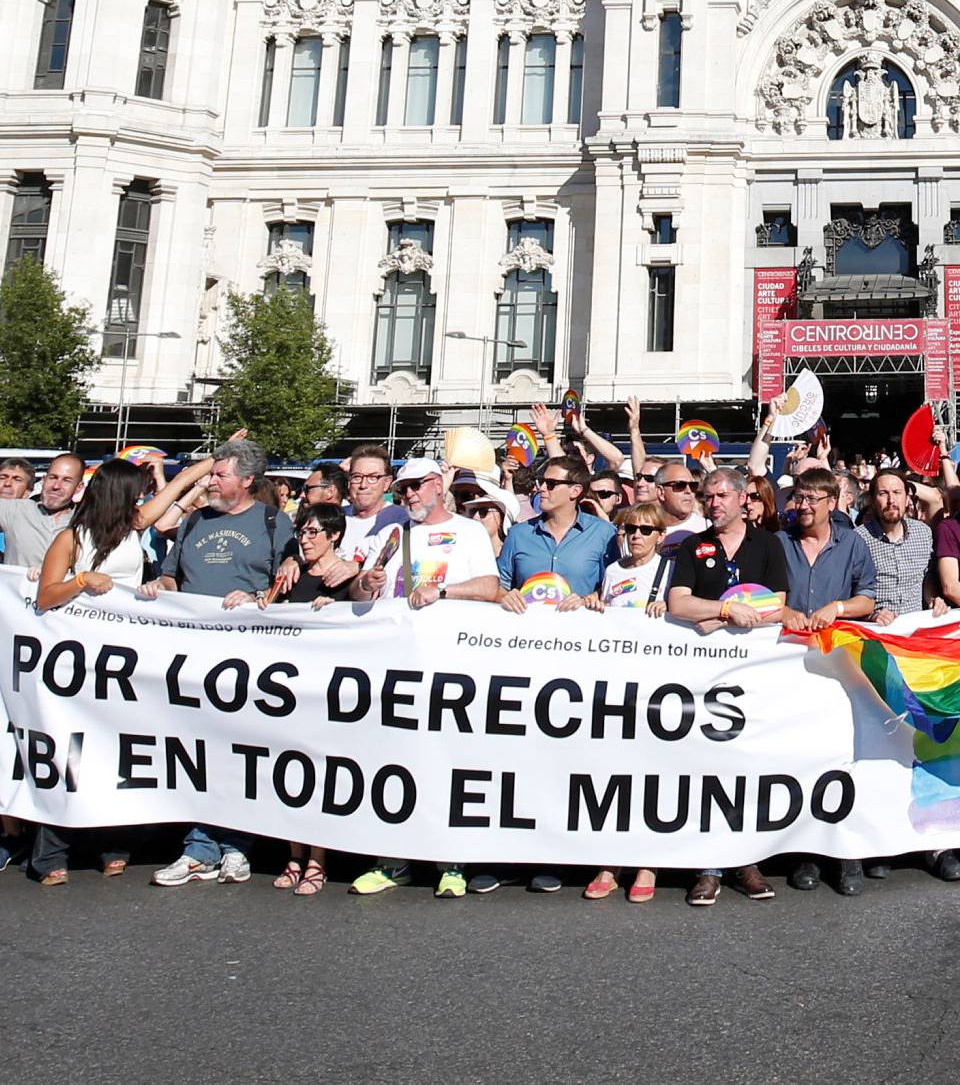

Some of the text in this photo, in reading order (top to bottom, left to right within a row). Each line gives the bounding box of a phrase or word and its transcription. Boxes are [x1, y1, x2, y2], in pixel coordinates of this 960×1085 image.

[873, 342, 917, 350] CIUDADANÍA
[516, 431, 530, 450] Cs
[689, 429, 707, 441] Cs
[208, 529, 252, 547] WASHINGTON
[532, 584, 557, 600] Cs
[251, 622, 303, 638] mundo
[457, 631, 749, 659] Polos derechos LGTBI en tol mundu
[12, 634, 746, 742] POR LOS DERECHOS
[117, 733, 208, 792] EN
[232, 743, 417, 825] TODO
[448, 768, 537, 830] EL
[567, 769, 856, 834] MUNDO
